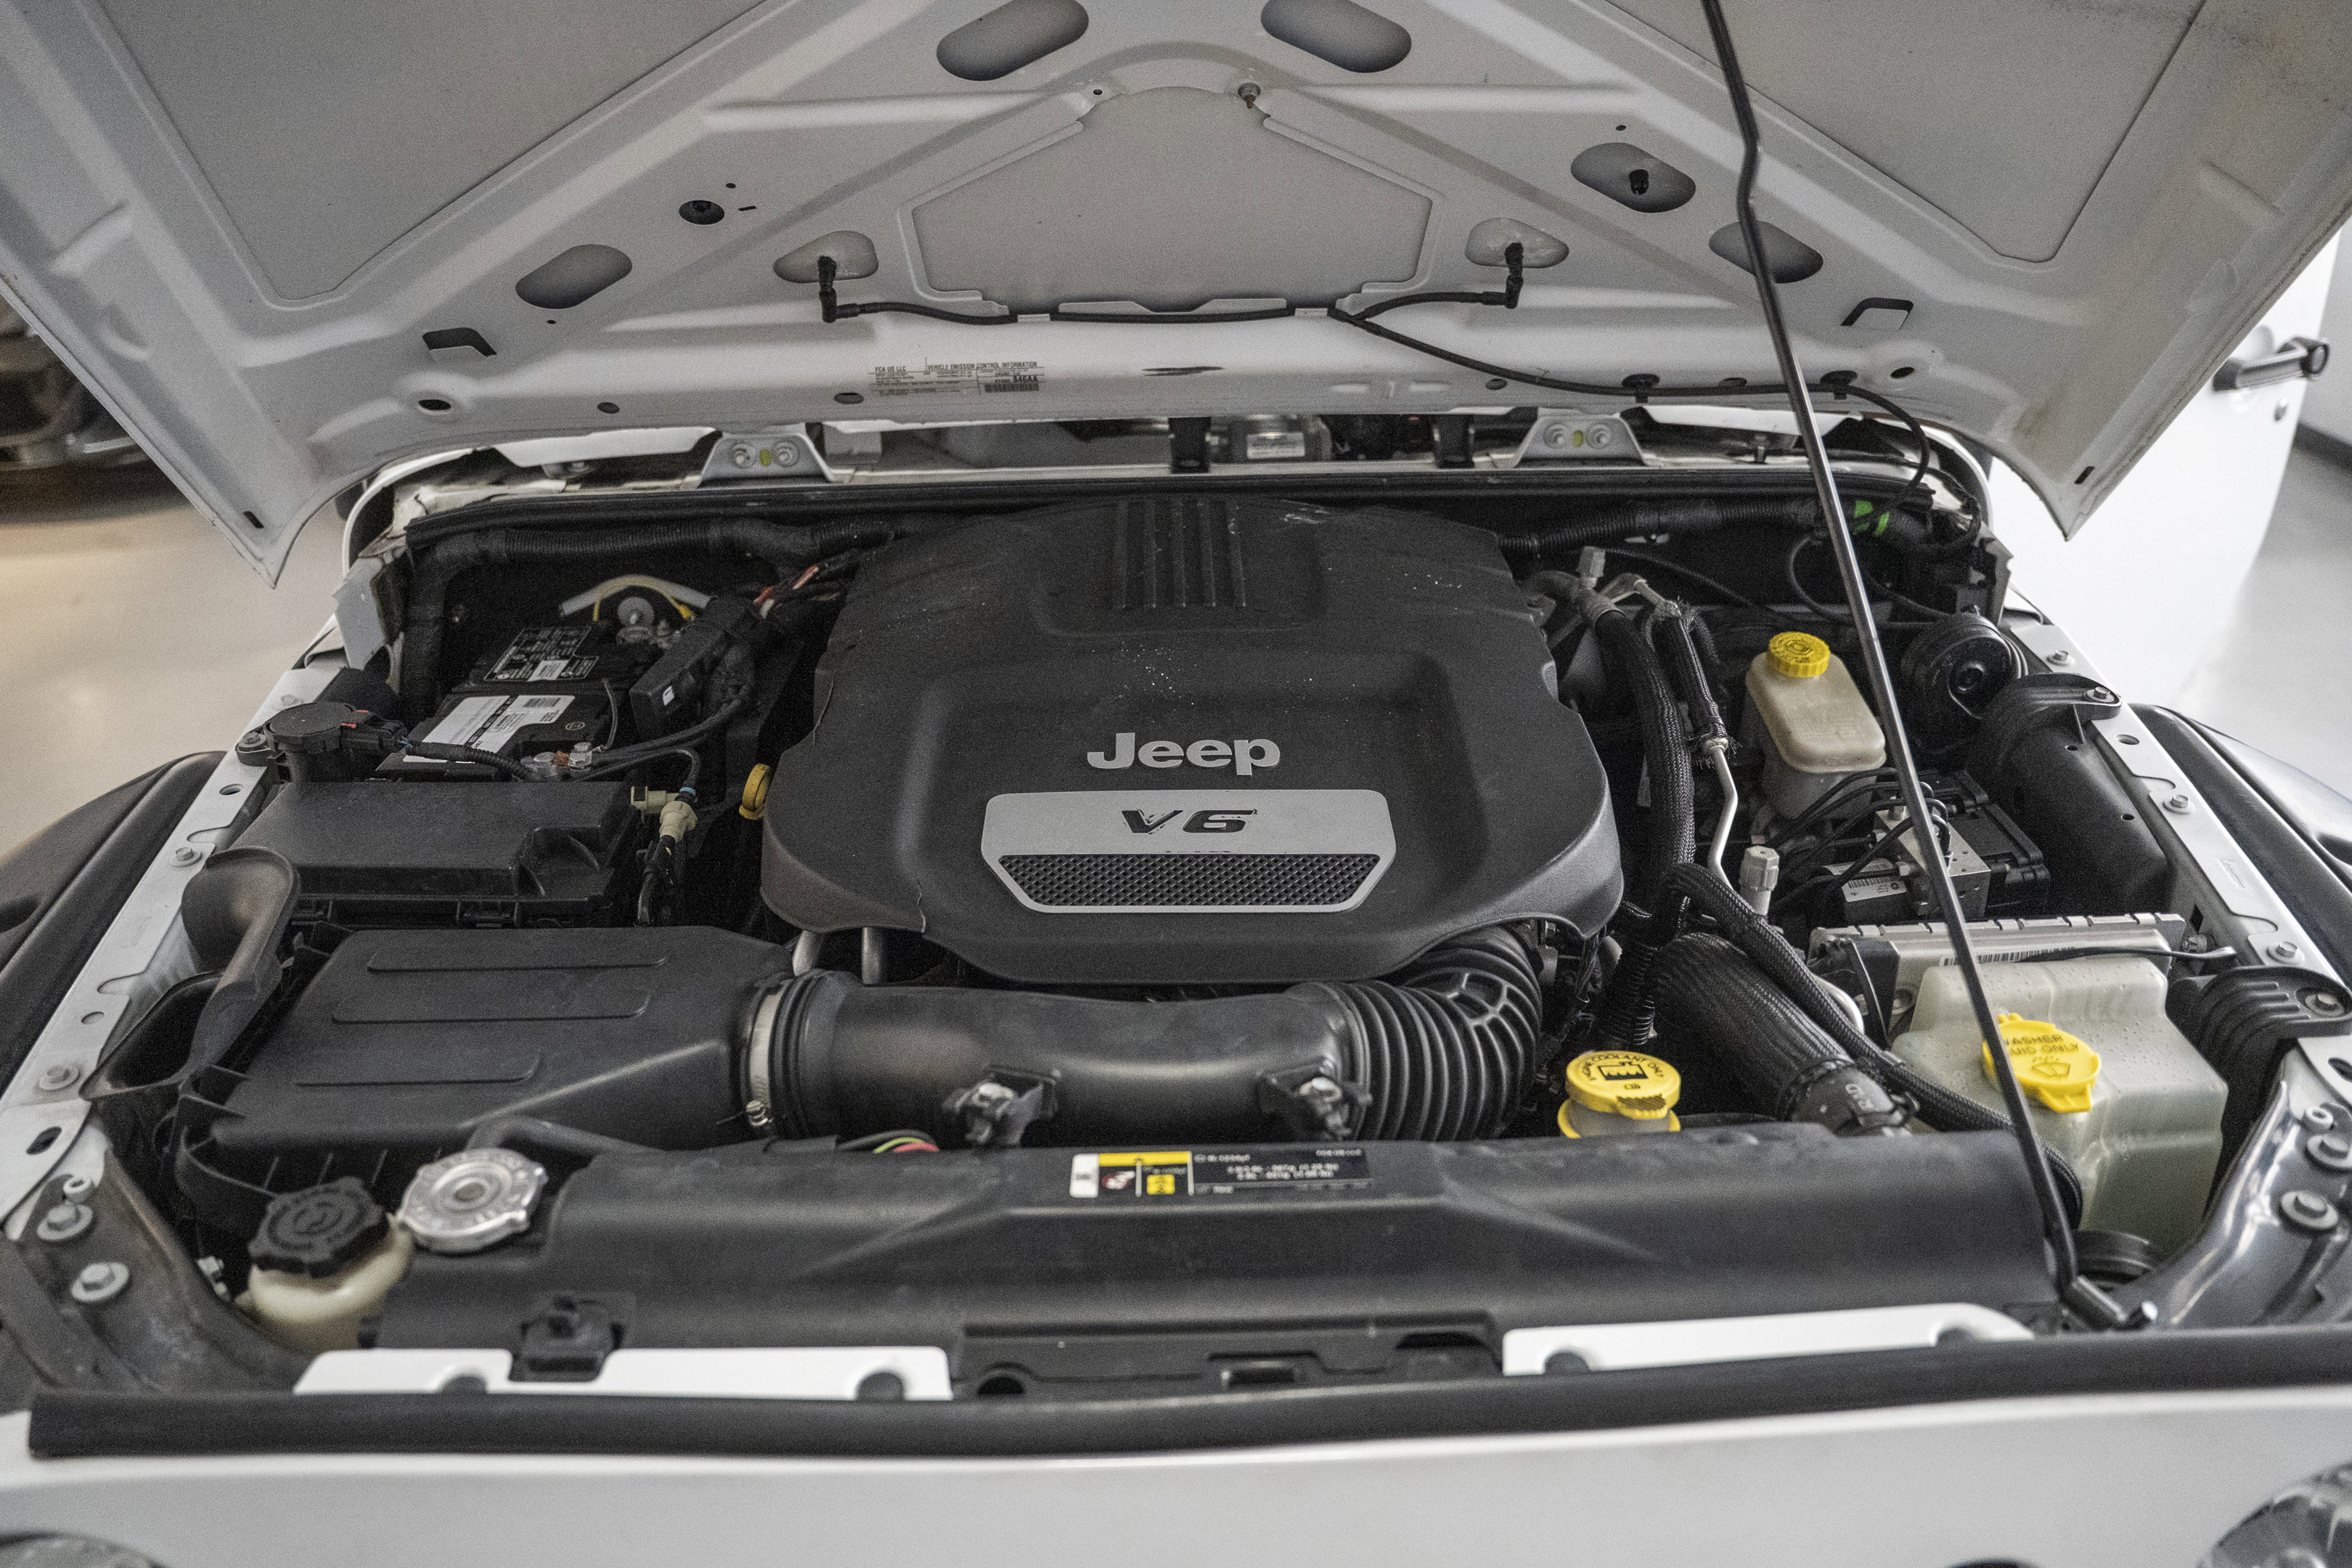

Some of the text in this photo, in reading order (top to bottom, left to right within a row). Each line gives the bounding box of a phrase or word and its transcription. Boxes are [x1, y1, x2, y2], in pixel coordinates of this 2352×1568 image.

[1087, 732, 1281, 776] Jeep
[1121, 808, 1258, 835] V6
[1591, 1053, 1646, 1063] COOLANT
[2010, 1043, 2079, 1055] UID ONLY
